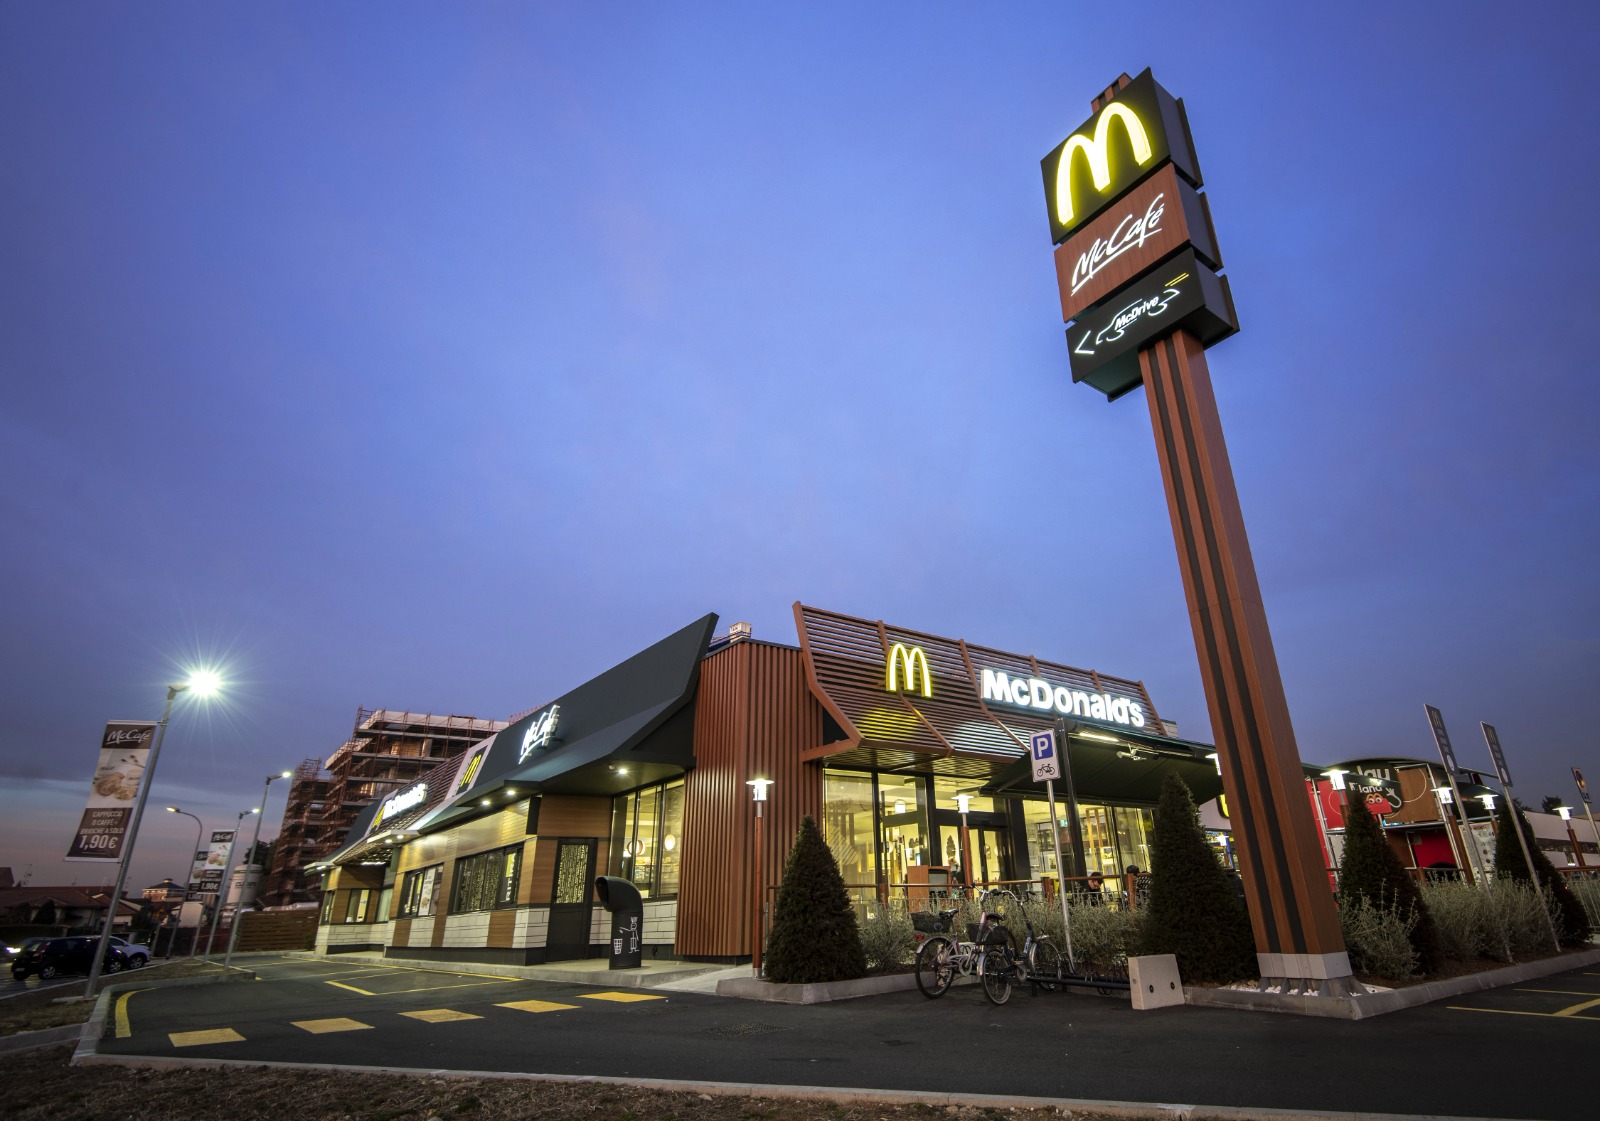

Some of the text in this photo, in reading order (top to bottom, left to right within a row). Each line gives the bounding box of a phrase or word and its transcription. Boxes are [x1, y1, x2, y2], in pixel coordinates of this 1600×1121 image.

[1071, 192, 1165, 296] McCafé
[1114, 295, 1159, 331] McDrive
[981, 669, 1145, 727] McDonald's
[1036, 736, 1050, 758] P
